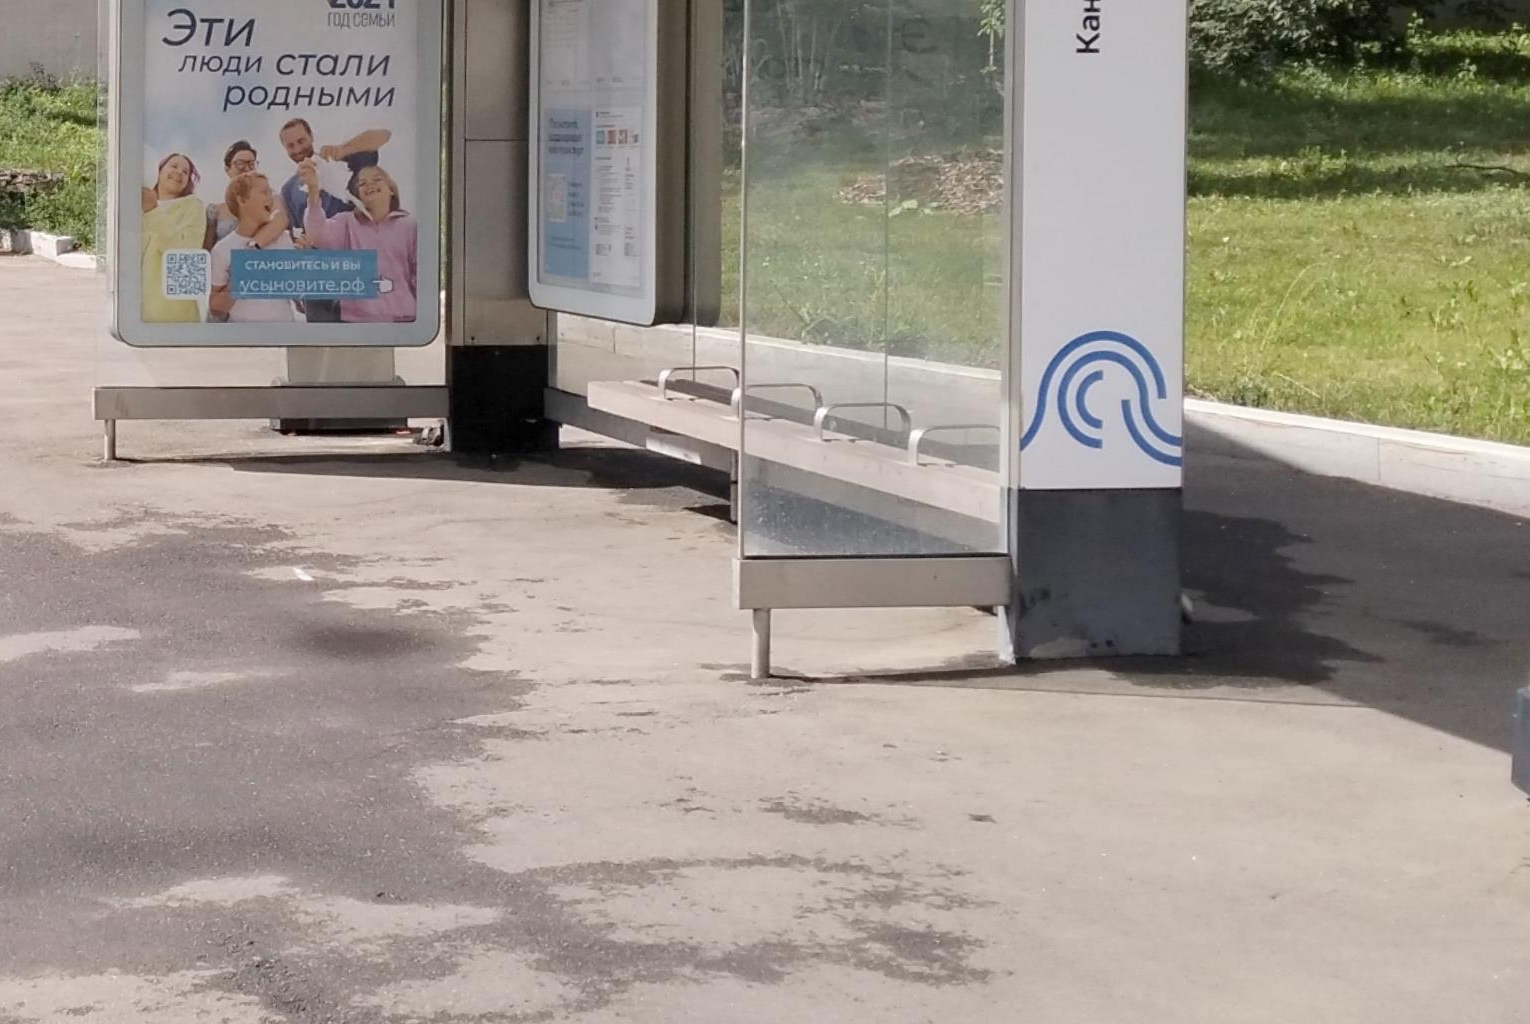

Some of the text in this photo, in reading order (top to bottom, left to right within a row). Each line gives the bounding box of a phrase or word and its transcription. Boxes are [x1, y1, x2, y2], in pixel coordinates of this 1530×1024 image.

[161, 8, 256, 47] Эти
[327, 12, 350, 29] ГОД
[178, 53, 391, 76] люди стали
[222, 85, 396, 113] родными
[244, 260, 361, 271] СТАНОВИТЕСЬ И ВЫ
[240, 277, 365, 293] усыновите.рф
